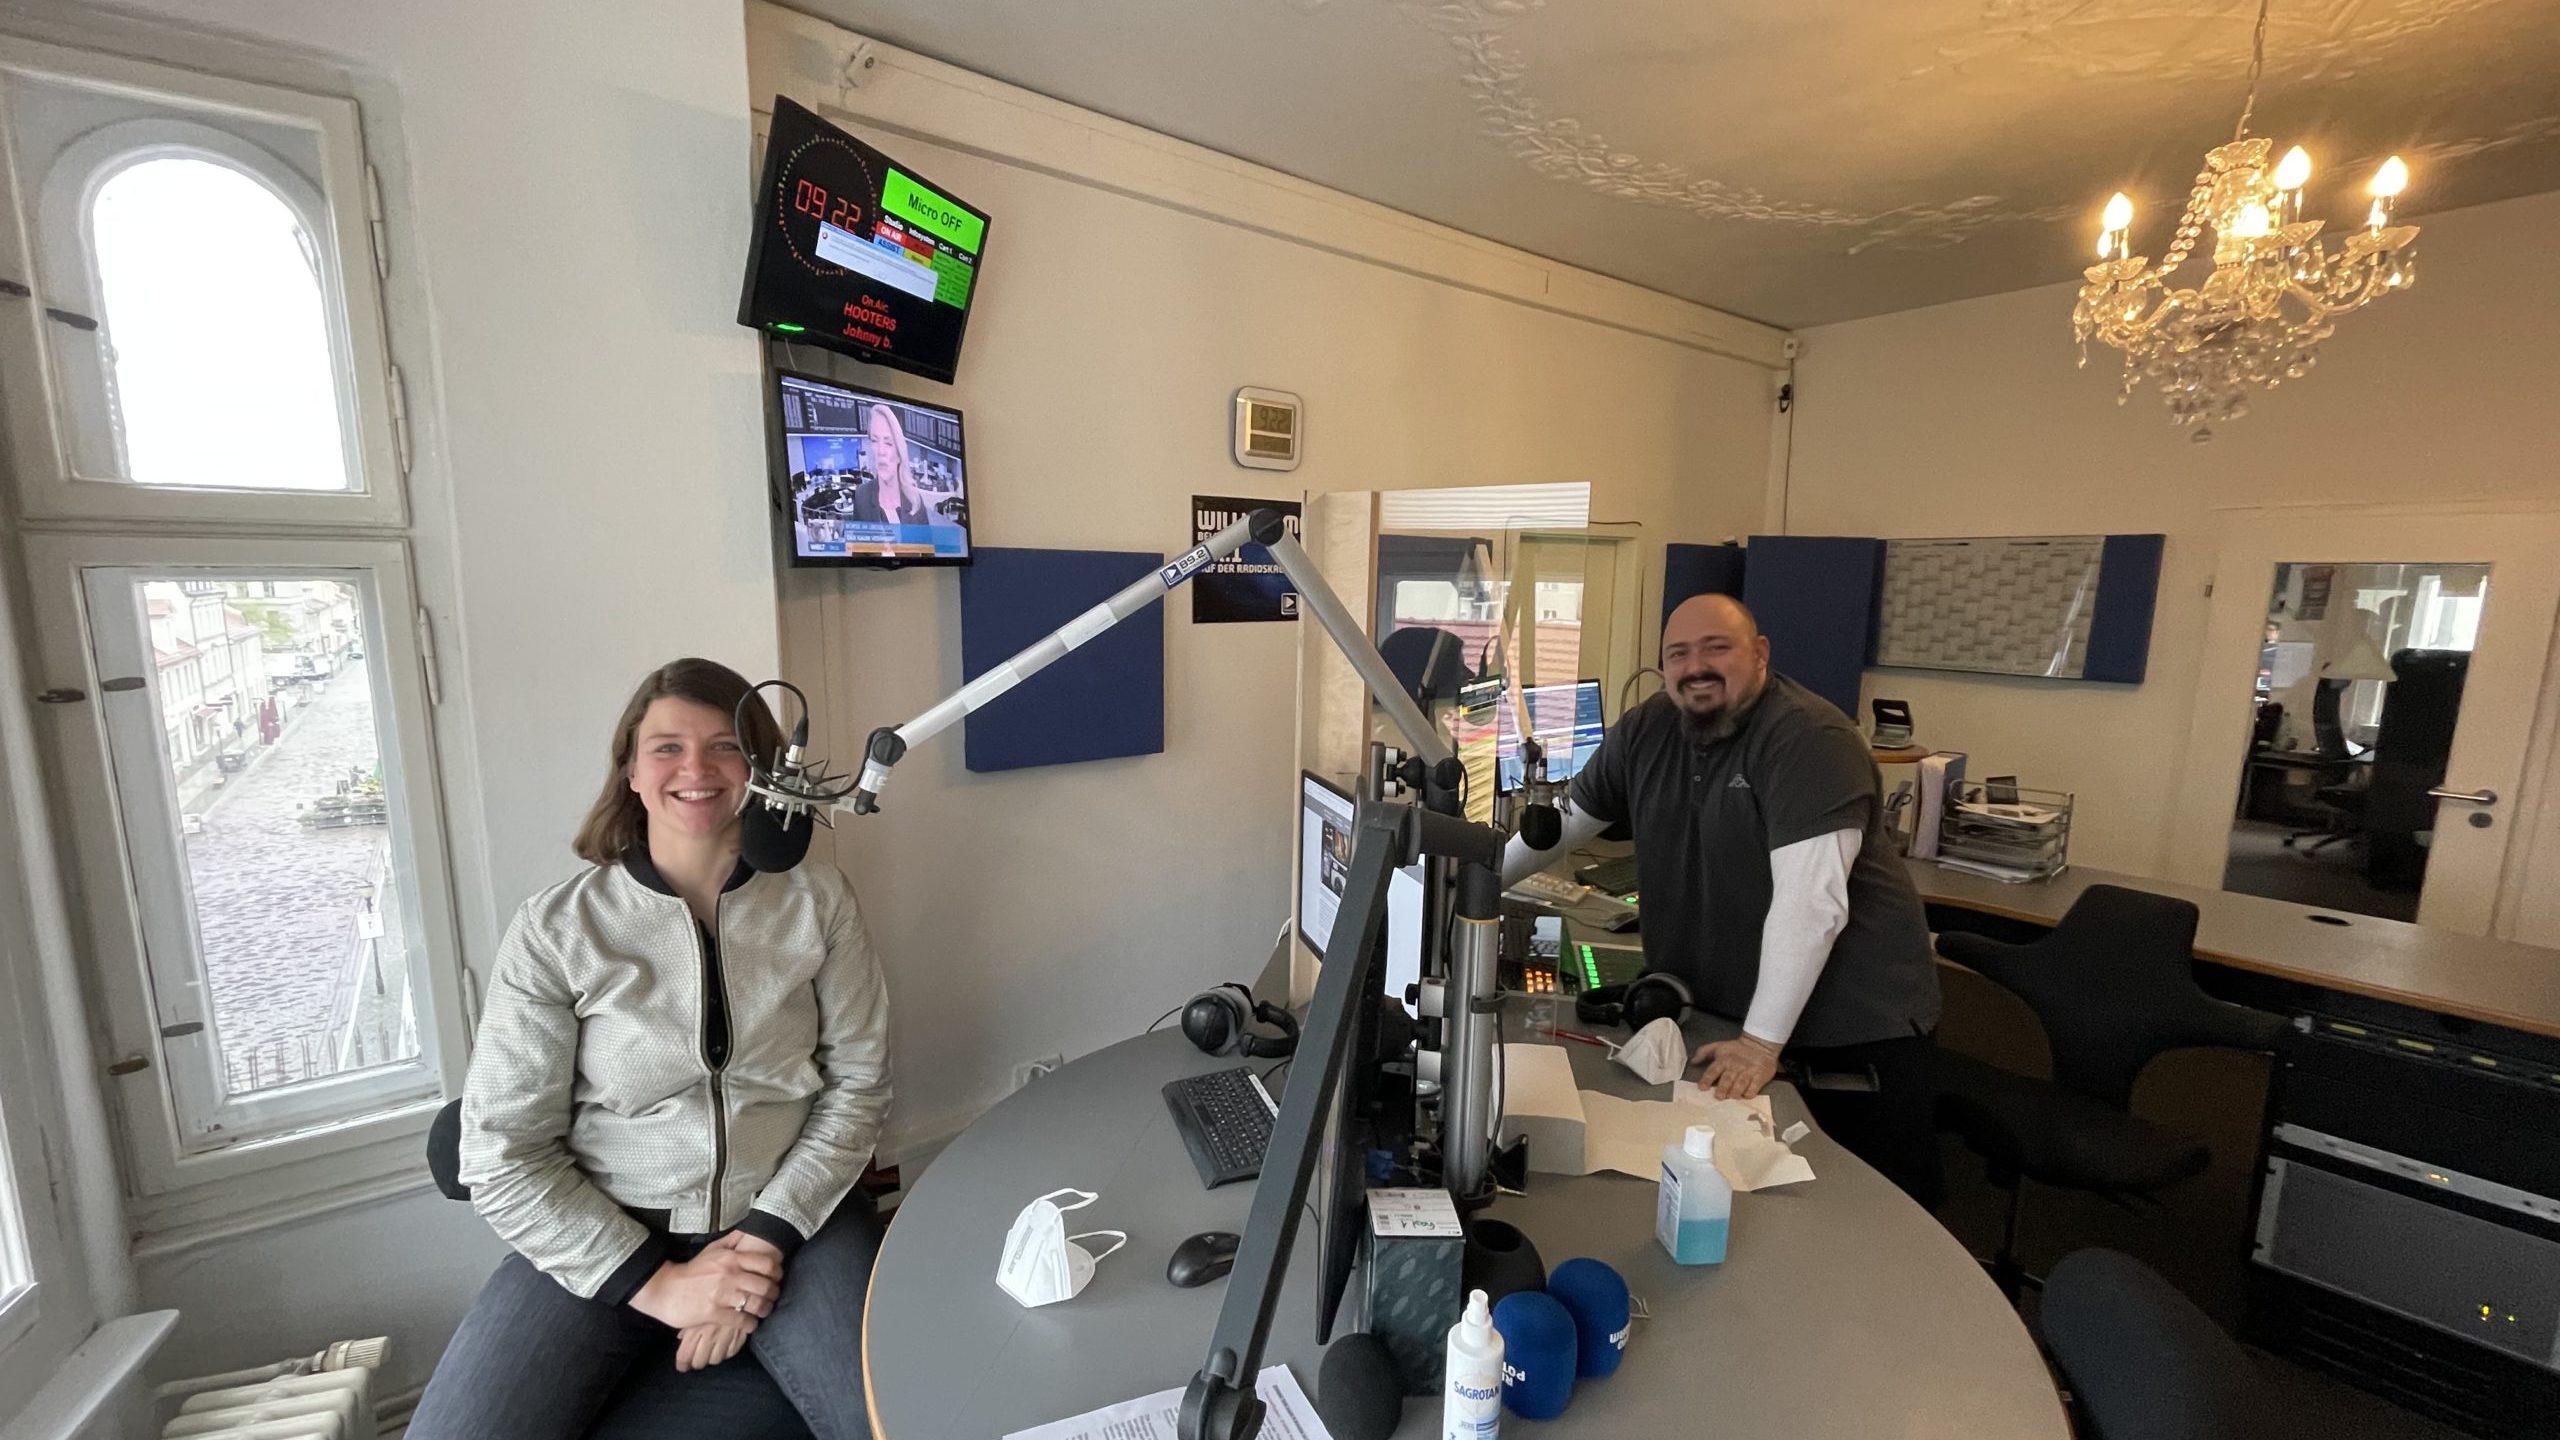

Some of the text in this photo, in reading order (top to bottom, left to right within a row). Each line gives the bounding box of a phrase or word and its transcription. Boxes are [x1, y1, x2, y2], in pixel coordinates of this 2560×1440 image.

[908, 192, 963, 232] Micro OFF
[880, 226, 892, 237] ON
[843, 302, 897, 332] HOOTERS
[843, 322, 882, 348] Johnny
[1179, 549, 1206, 569] 89.2
[1217, 564, 1235, 573] DER
[1453, 1380, 1500, 1401] SAGROTAN
